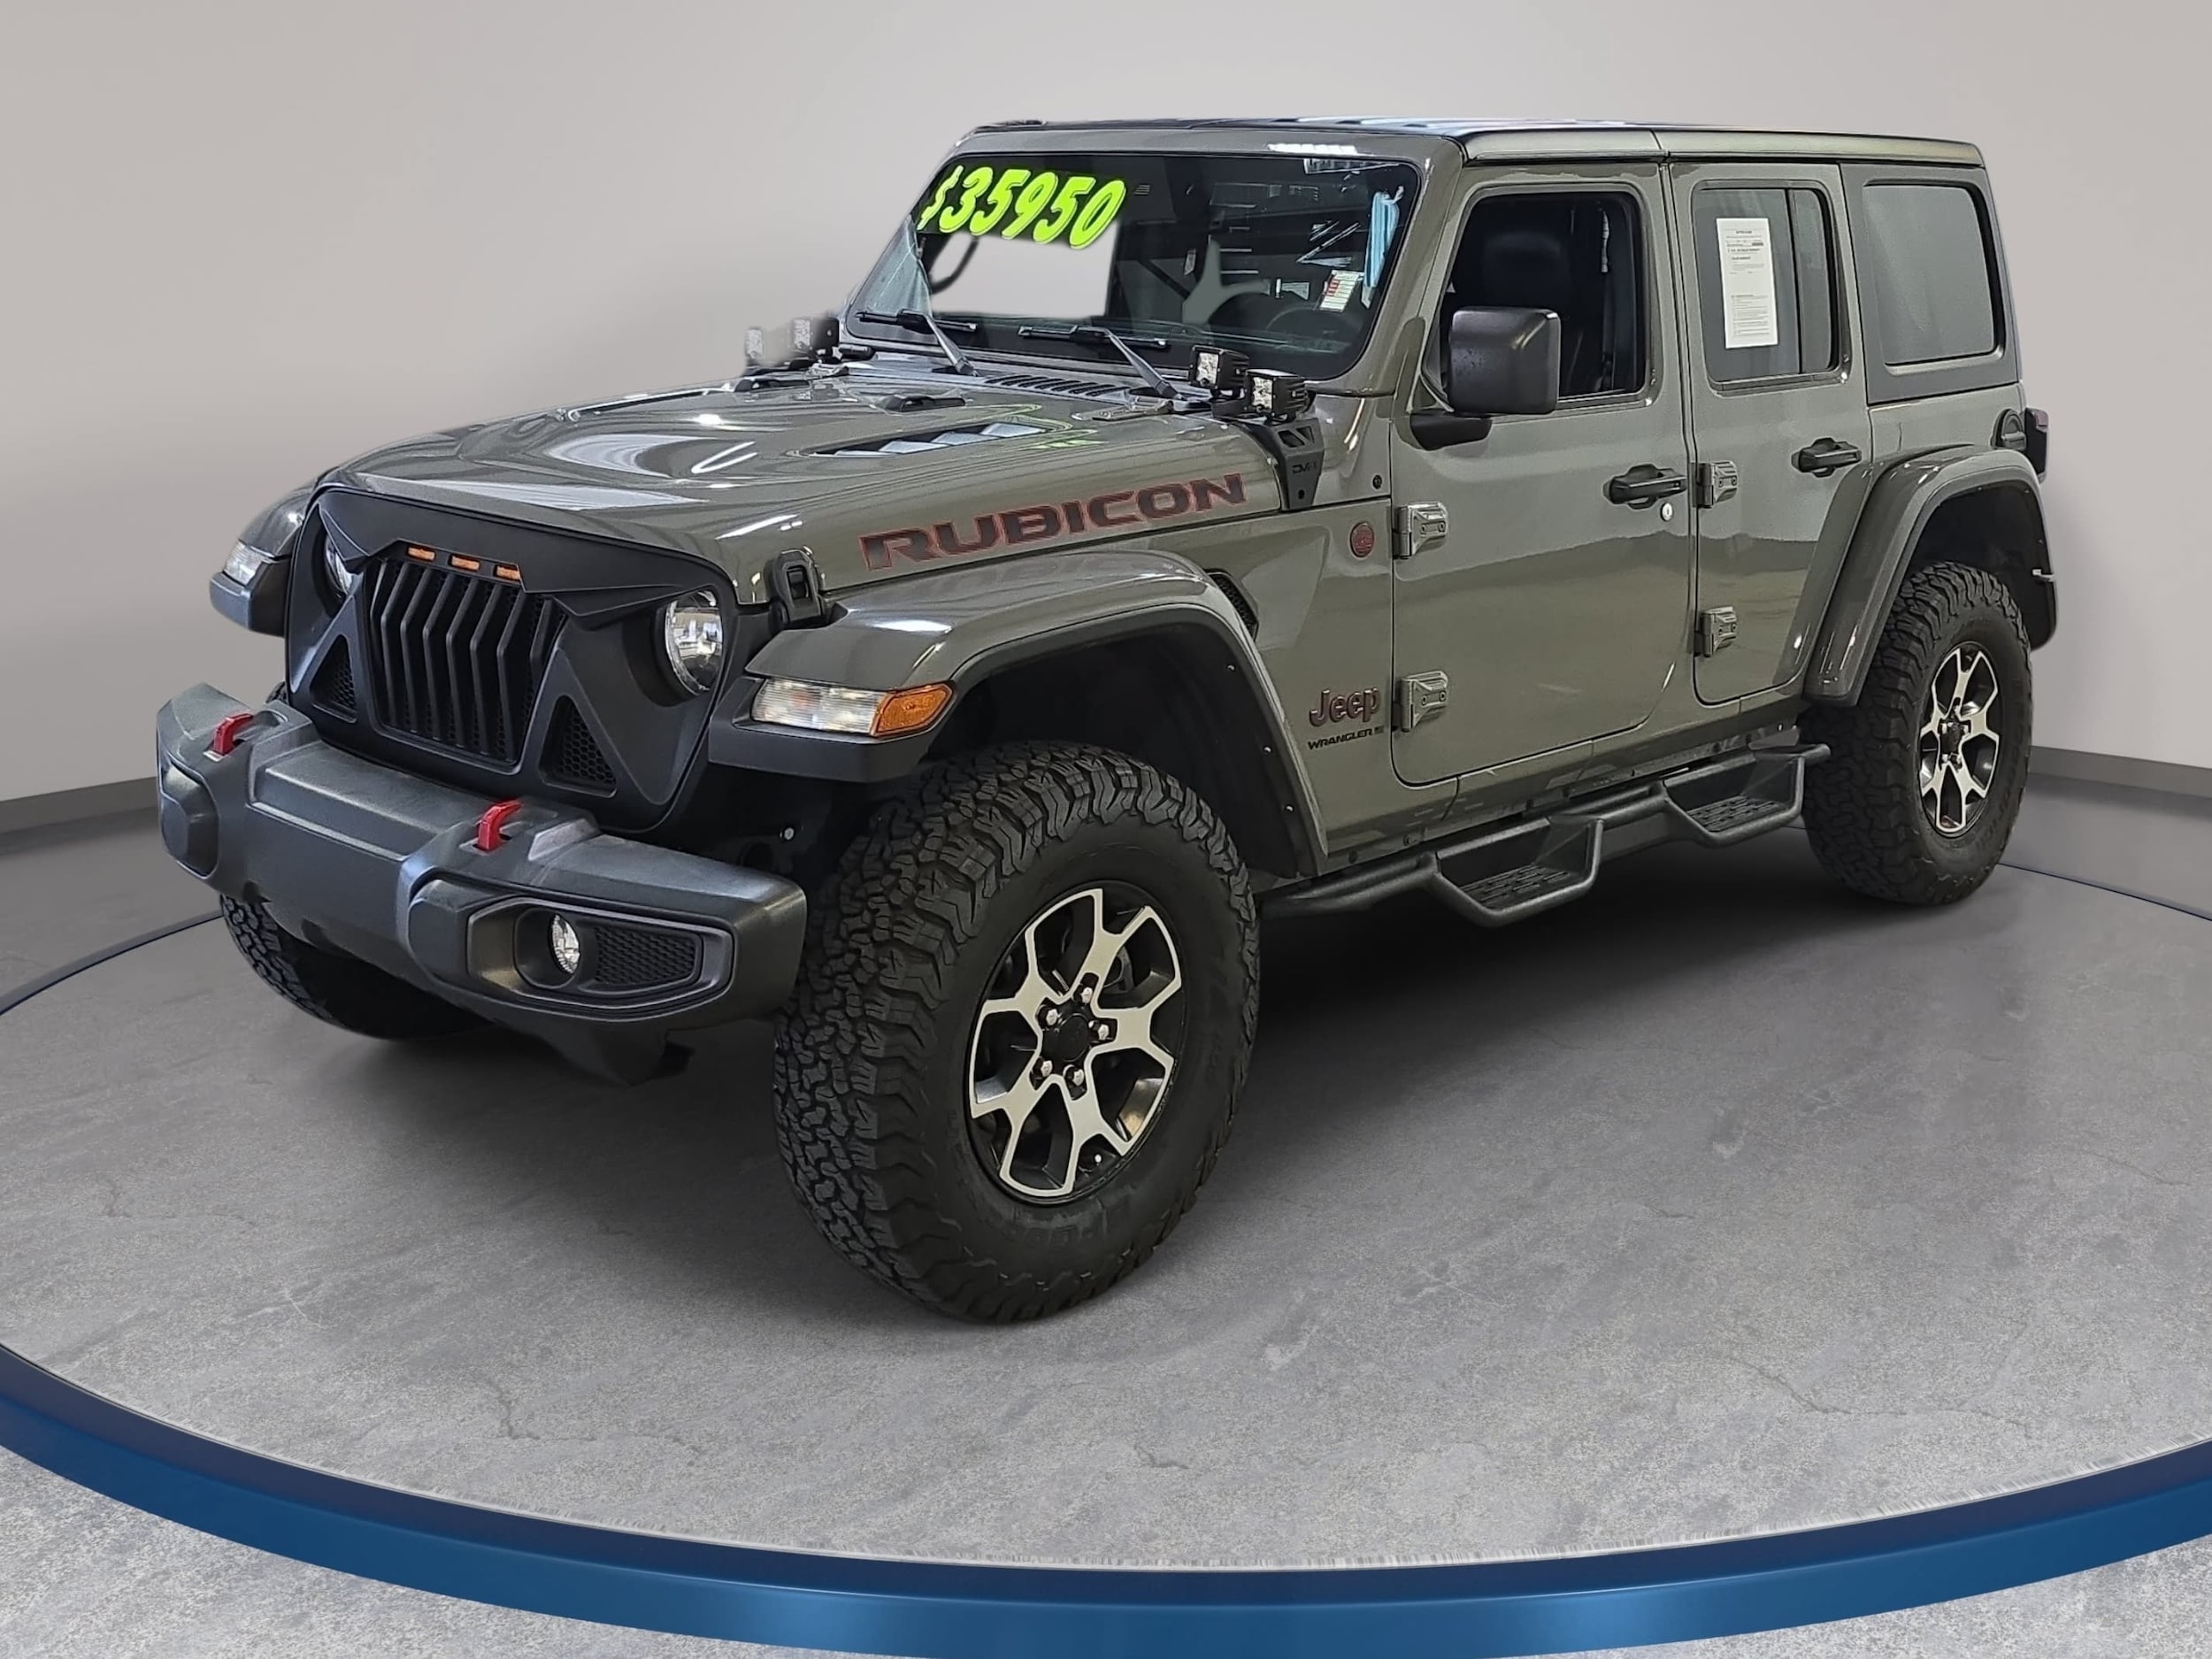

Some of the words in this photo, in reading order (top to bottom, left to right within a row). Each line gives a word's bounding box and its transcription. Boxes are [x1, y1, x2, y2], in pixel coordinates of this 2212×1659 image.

[917, 165, 1126, 250] $35950
[859, 472, 1247, 571] RUBICON
[1310, 687, 1381, 727] Jeep
[1308, 728, 1372, 750] WRANGLER
